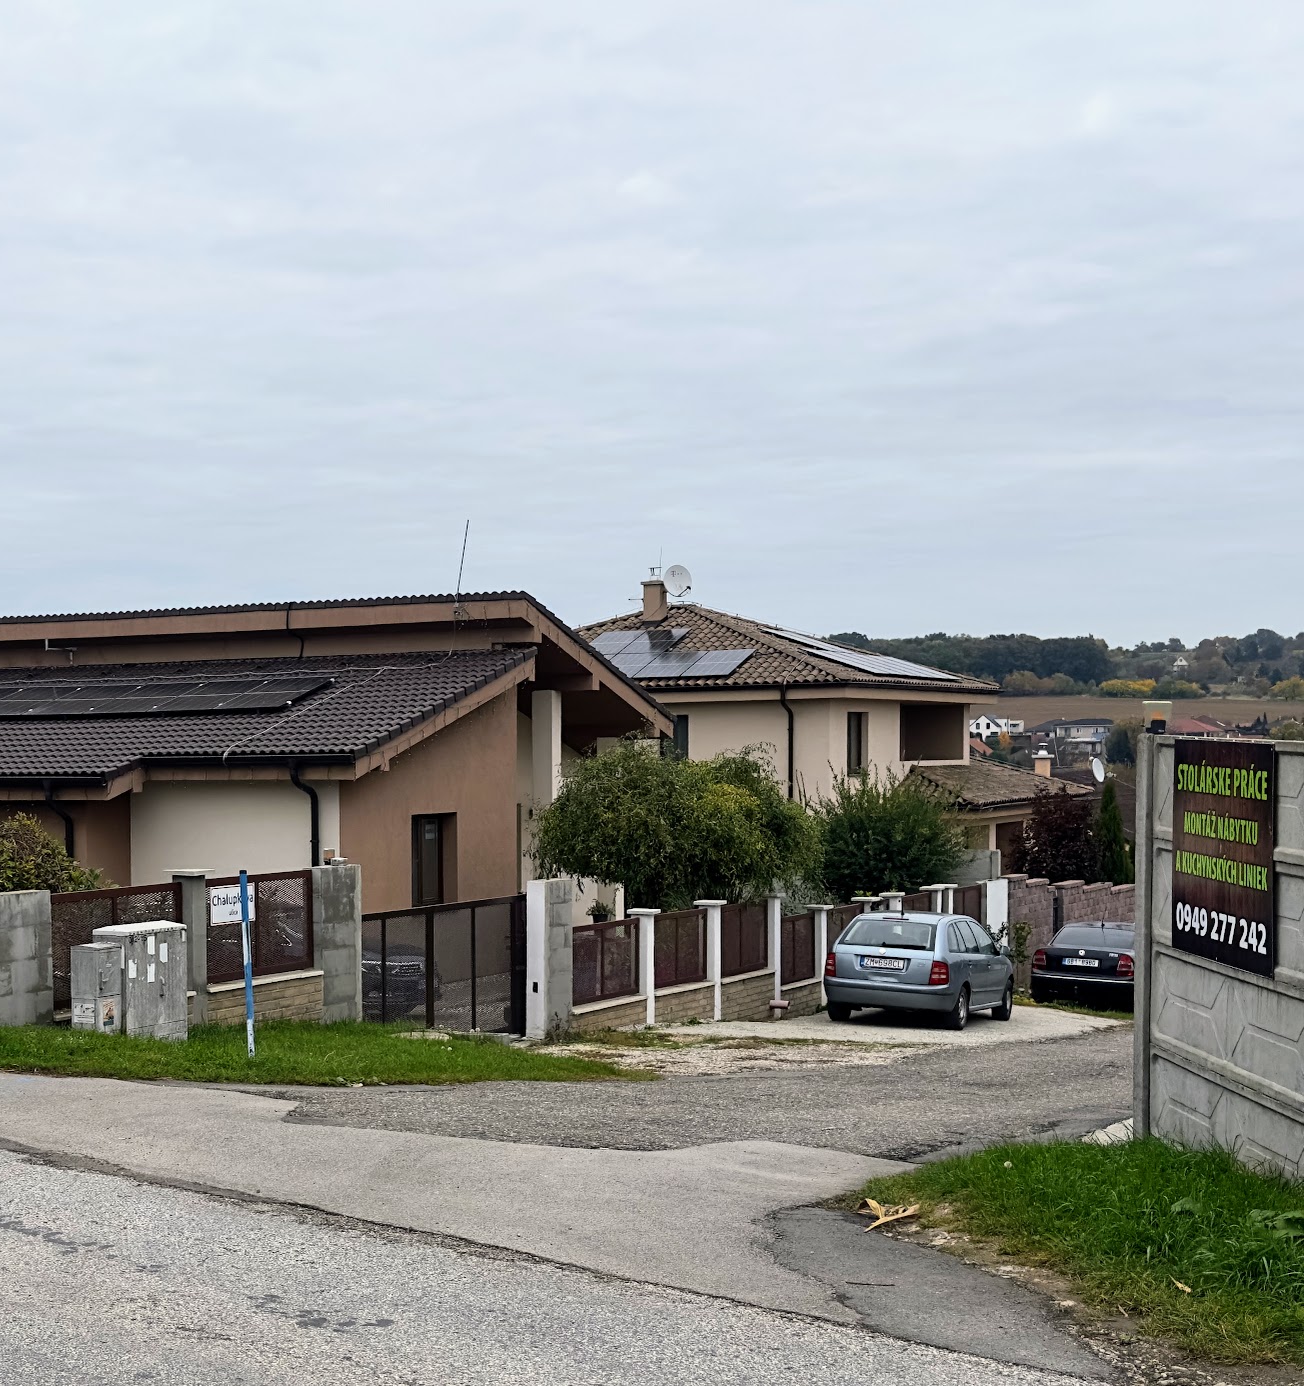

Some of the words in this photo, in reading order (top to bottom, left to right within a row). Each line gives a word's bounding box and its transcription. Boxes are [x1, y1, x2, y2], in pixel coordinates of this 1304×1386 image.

[1178, 760, 1231, 796] STOLÁRSKE
[1234, 764, 1268, 800] PRÁCE
[1184, 810, 1216, 838] MONTÁŽ
[1218, 812, 1258, 846] NÁBYTKU
[1176, 850, 1181, 872] A
[1182, 851, 1237, 884] KUCHYNSKÝCH
[1239, 862, 1268, 892] LINIEK
[1176, 902, 1208, 936] 0949
[1210, 910, 1236, 944] 277
[1239, 918, 1267, 954] 242
